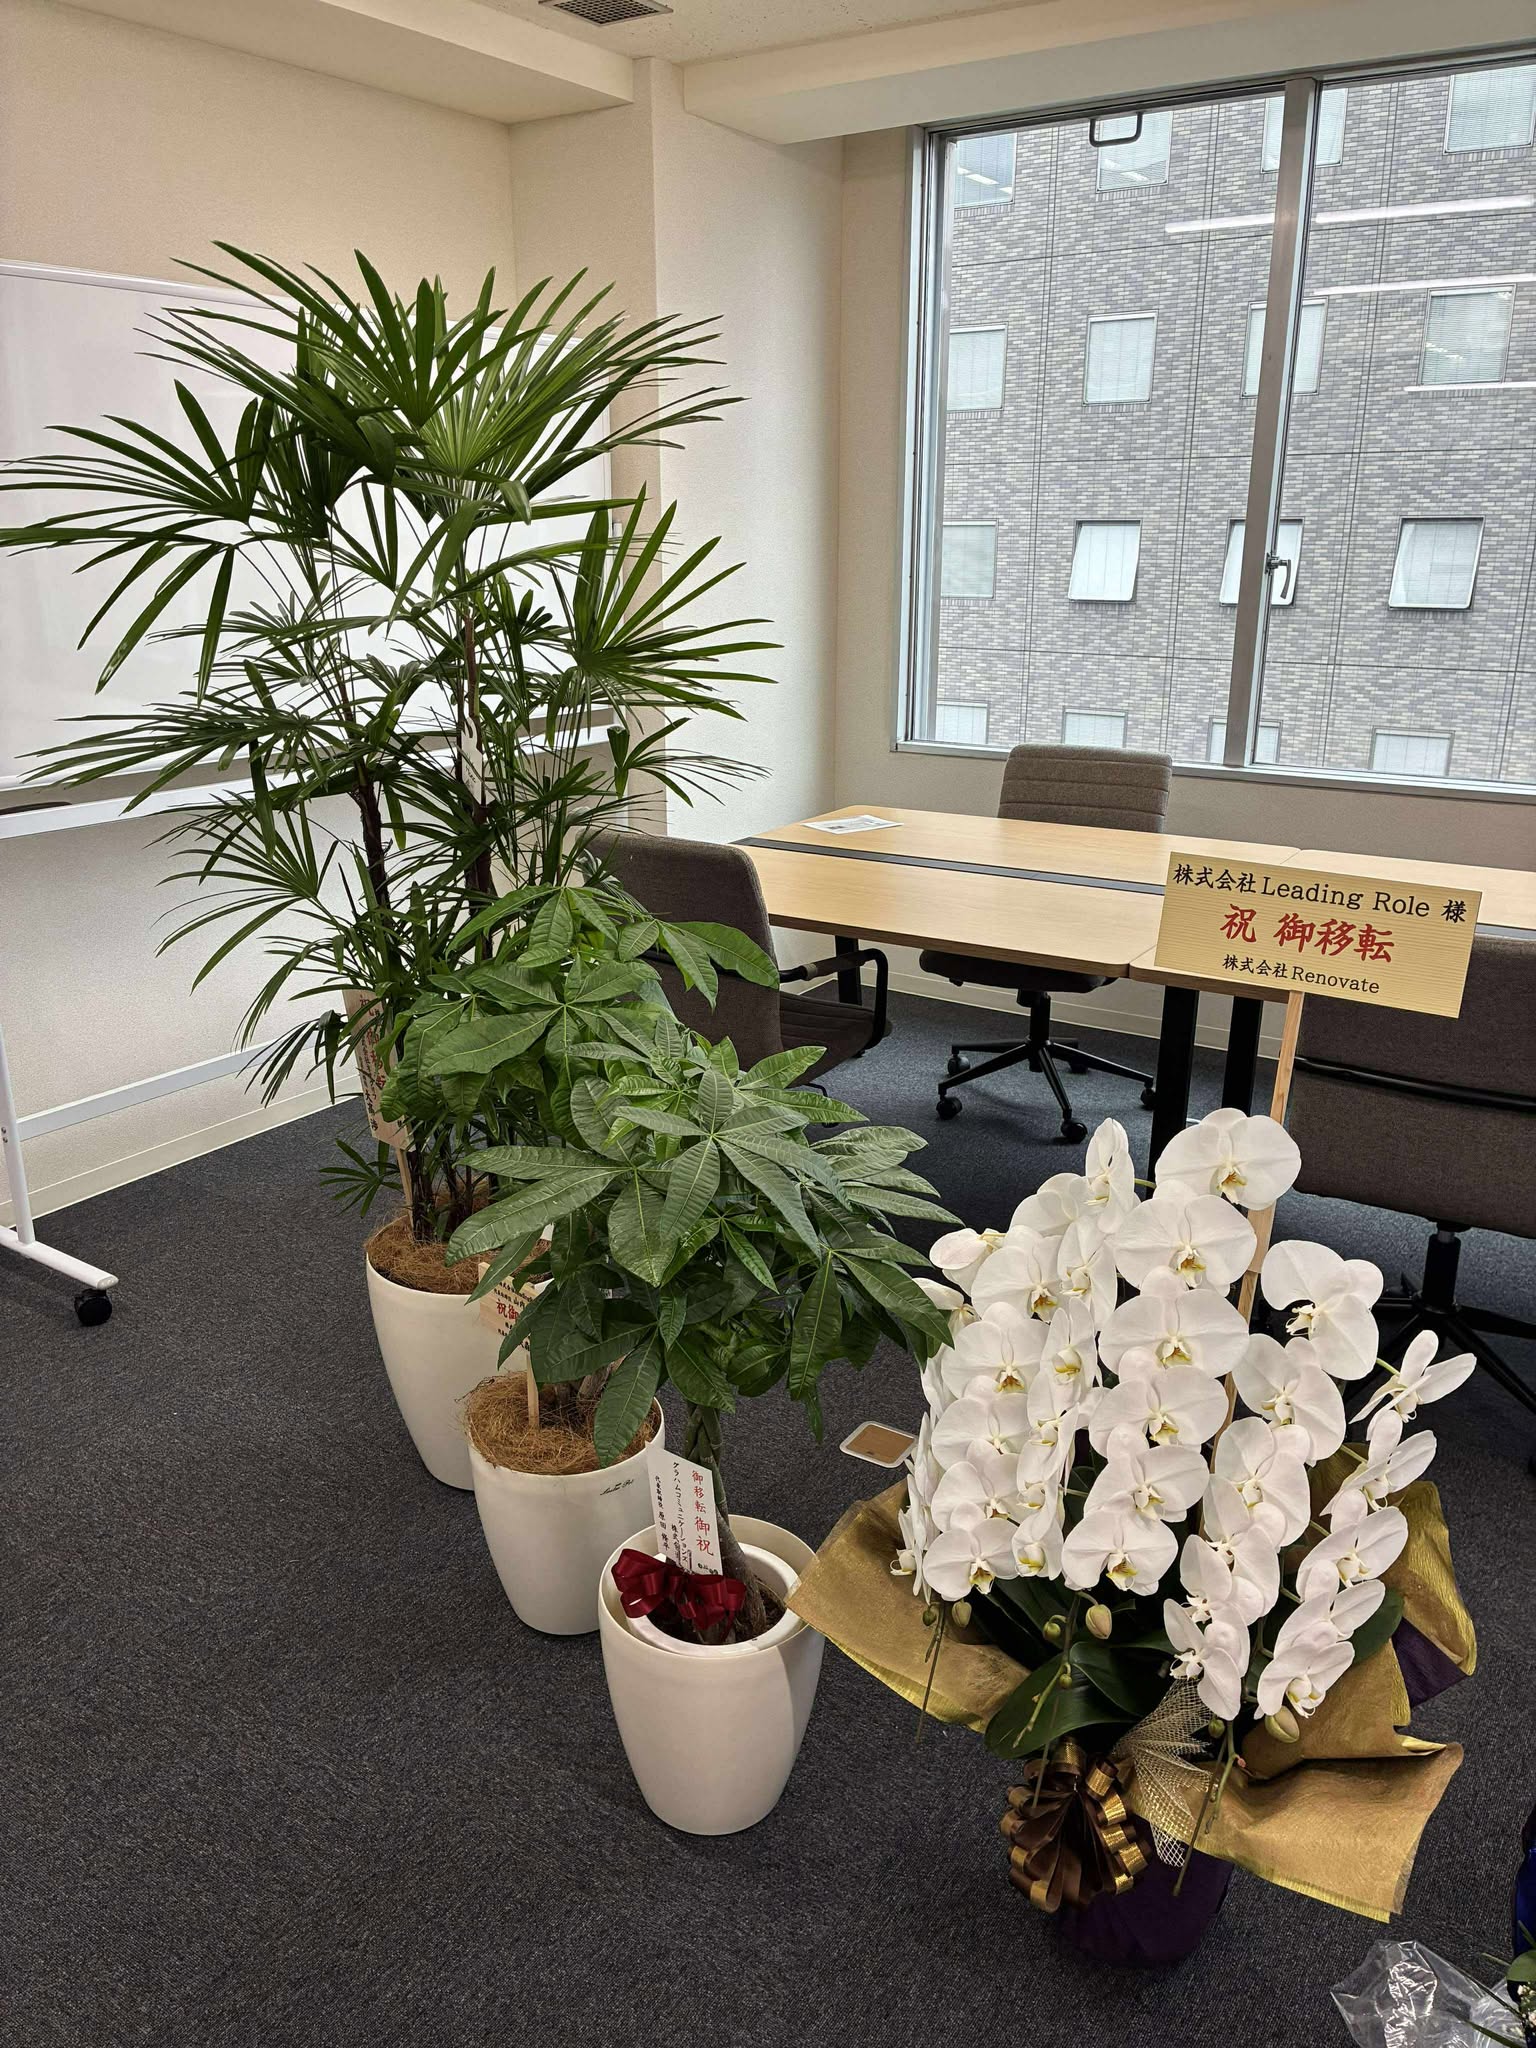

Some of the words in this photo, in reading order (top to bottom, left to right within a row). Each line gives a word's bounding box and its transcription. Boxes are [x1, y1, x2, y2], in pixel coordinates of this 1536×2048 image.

[1219, 904, 1257, 943] 祝
[1273, 912, 1395, 963] 御移転
[1372, 891, 1430, 917] Role
[1441, 899, 1467, 923] 様
[692, 1470, 714, 1556] 御移転御祝
